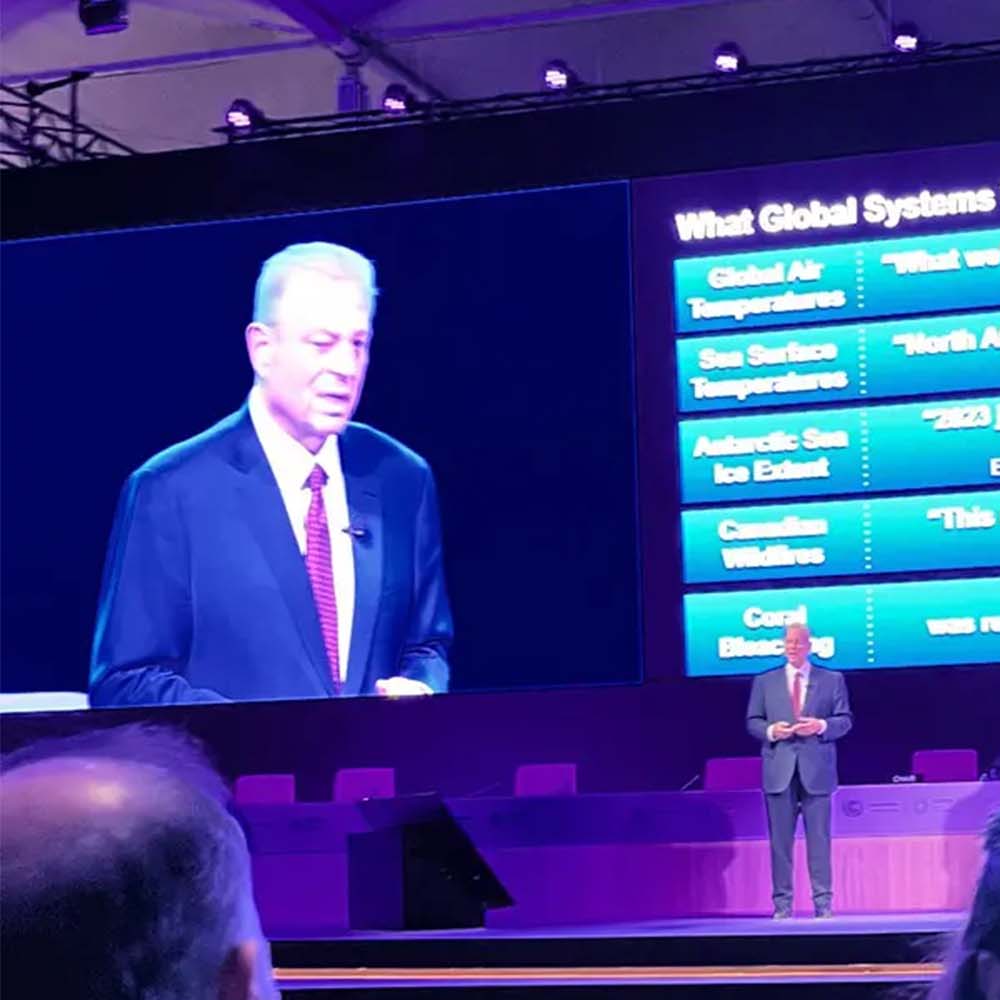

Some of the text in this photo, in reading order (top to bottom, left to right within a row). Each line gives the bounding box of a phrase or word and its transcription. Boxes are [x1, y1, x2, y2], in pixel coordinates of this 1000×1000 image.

[675, 209, 756, 241] What
[759, 196, 857, 233] Global
[863, 188, 996, 228] Systems
[708, 260, 823, 288] Global Air
[687, 291, 846, 320] Temperatures
[699, 342, 838, 369] Sea Surface
[690, 372, 849, 401] Temperatures
[693, 427, 849, 457] Antarctic Sea
[714, 457, 830, 484] Ice Extent
[718, 516, 828, 541] Canadian
[722, 544, 825, 569] Wildfires
[926, 617, 976, 636] was
